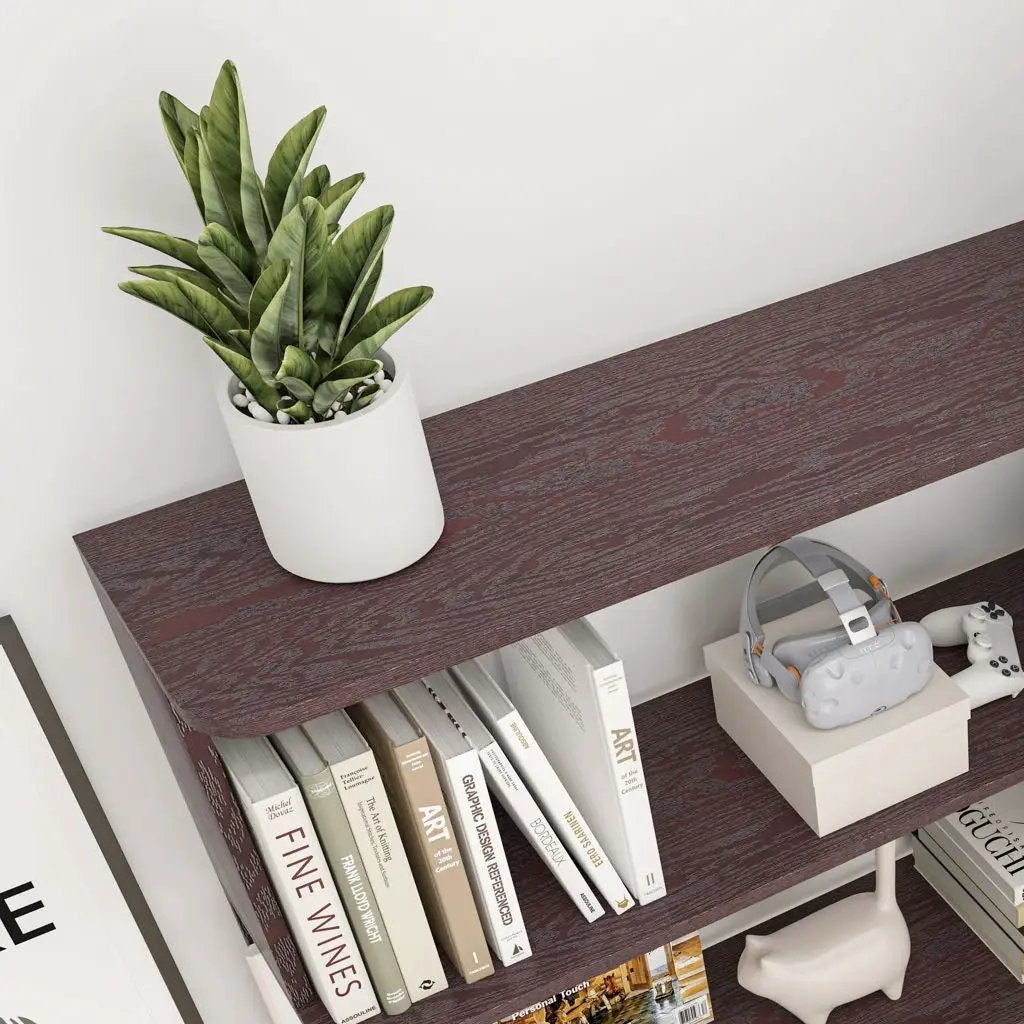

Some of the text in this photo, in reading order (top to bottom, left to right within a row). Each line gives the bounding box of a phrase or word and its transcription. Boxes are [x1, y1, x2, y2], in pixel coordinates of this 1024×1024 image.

[611, 728, 637, 764] ART
[621, 782, 644, 795] Century
[265, 797, 292, 815] Michel
[269, 807, 294, 821] Dovaz
[367, 797, 376, 812] The
[372, 812, 381, 826] Art
[419, 805, 450, 843] ART
[563, 810, 604, 869] EERO SAARINEN
[462, 774, 484, 822] GRAPHIC
[475, 823, 495, 862] DESIGN
[487, 862, 513, 926] REFERENCED
[530, 818, 567, 867] BORDEAUX
[340, 853, 361, 884] FRANK
[435, 860, 460, 873] Century
[275, 826, 325, 898] FINE
[307, 903, 362, 997] WINES
[349, 882, 371, 912] LLOYD
[0, 881, 57, 952] E
[360, 911, 382, 945] WRIGHT
[340, 1005, 377, 1024] ASSOULINE
[511, 980, 591, 1022] Personal Touch
